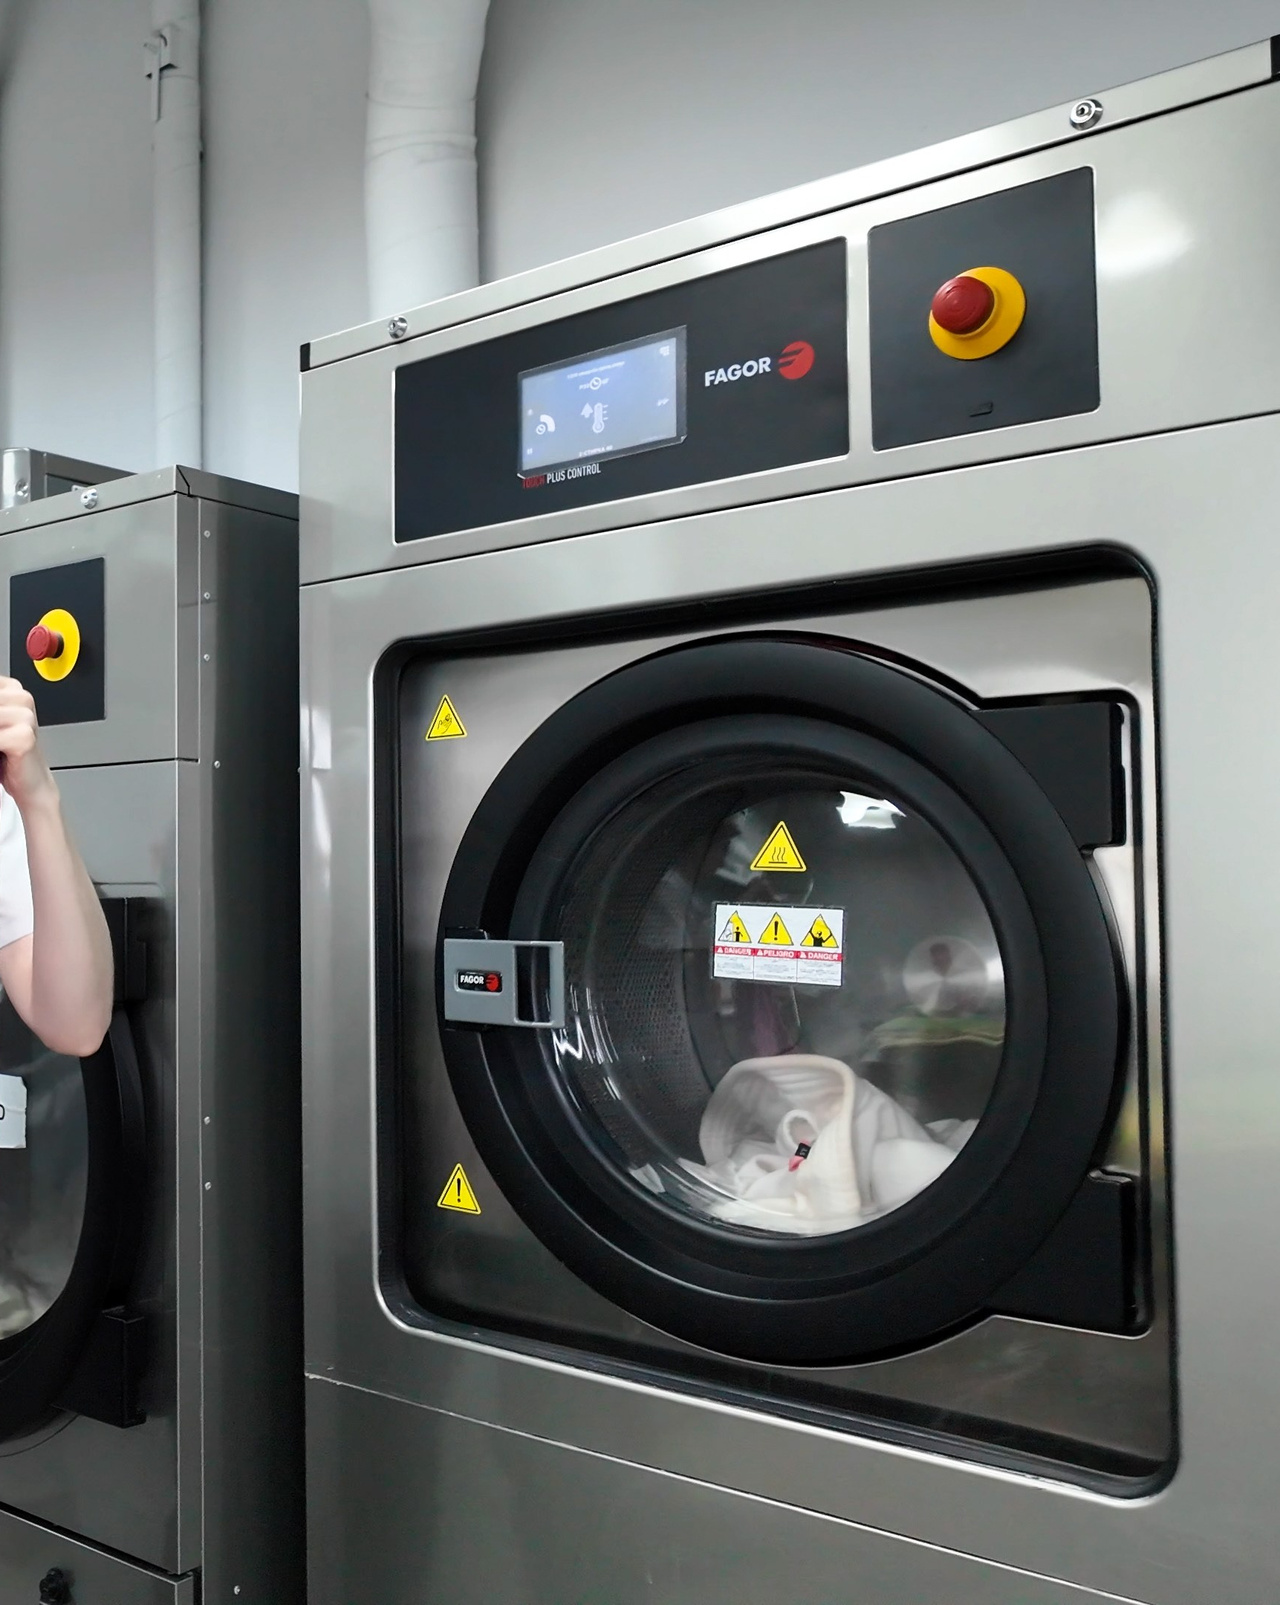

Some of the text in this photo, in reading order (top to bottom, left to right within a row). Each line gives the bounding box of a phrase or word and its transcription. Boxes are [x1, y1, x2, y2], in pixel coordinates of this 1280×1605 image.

[704, 355, 772, 388] FAGOR
[546, 470, 566, 484] PLUS
[567, 463, 602, 480] CONTROL
[764, 949, 795, 958] PELIGRO
[807, 951, 838, 961] DANGER
[460, 974, 485, 985] FAGOR
